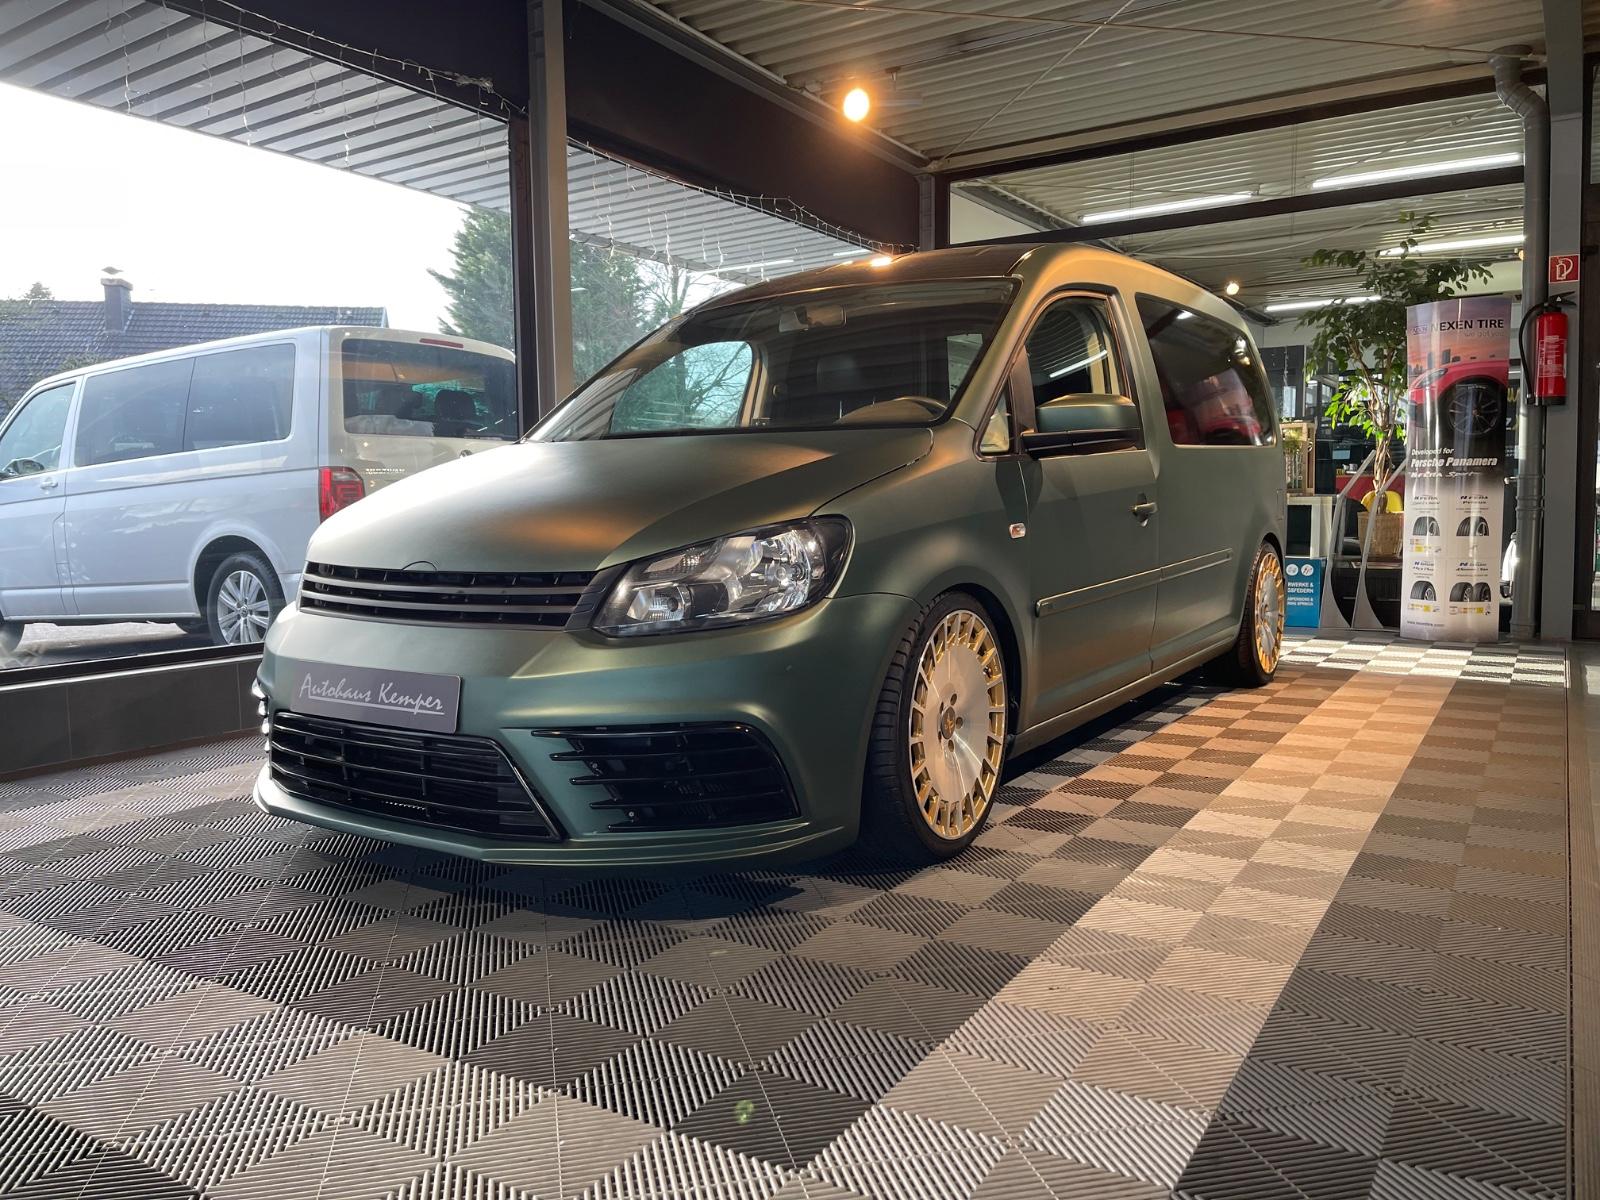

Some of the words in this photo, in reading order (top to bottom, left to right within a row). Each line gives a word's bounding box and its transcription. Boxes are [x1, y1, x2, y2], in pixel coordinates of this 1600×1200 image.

[1431, 319, 1473, 332] NEXEN
[1476, 319, 1504, 329] TIRE
[1411, 448, 1441, 456] Developed
[1443, 447, 1454, 455] for
[1411, 458, 1444, 468] Porsche
[1446, 457, 1498, 466] Panamera
[299, 672, 371, 700] Autohaus
[378, 682, 443, 715] Kemper
